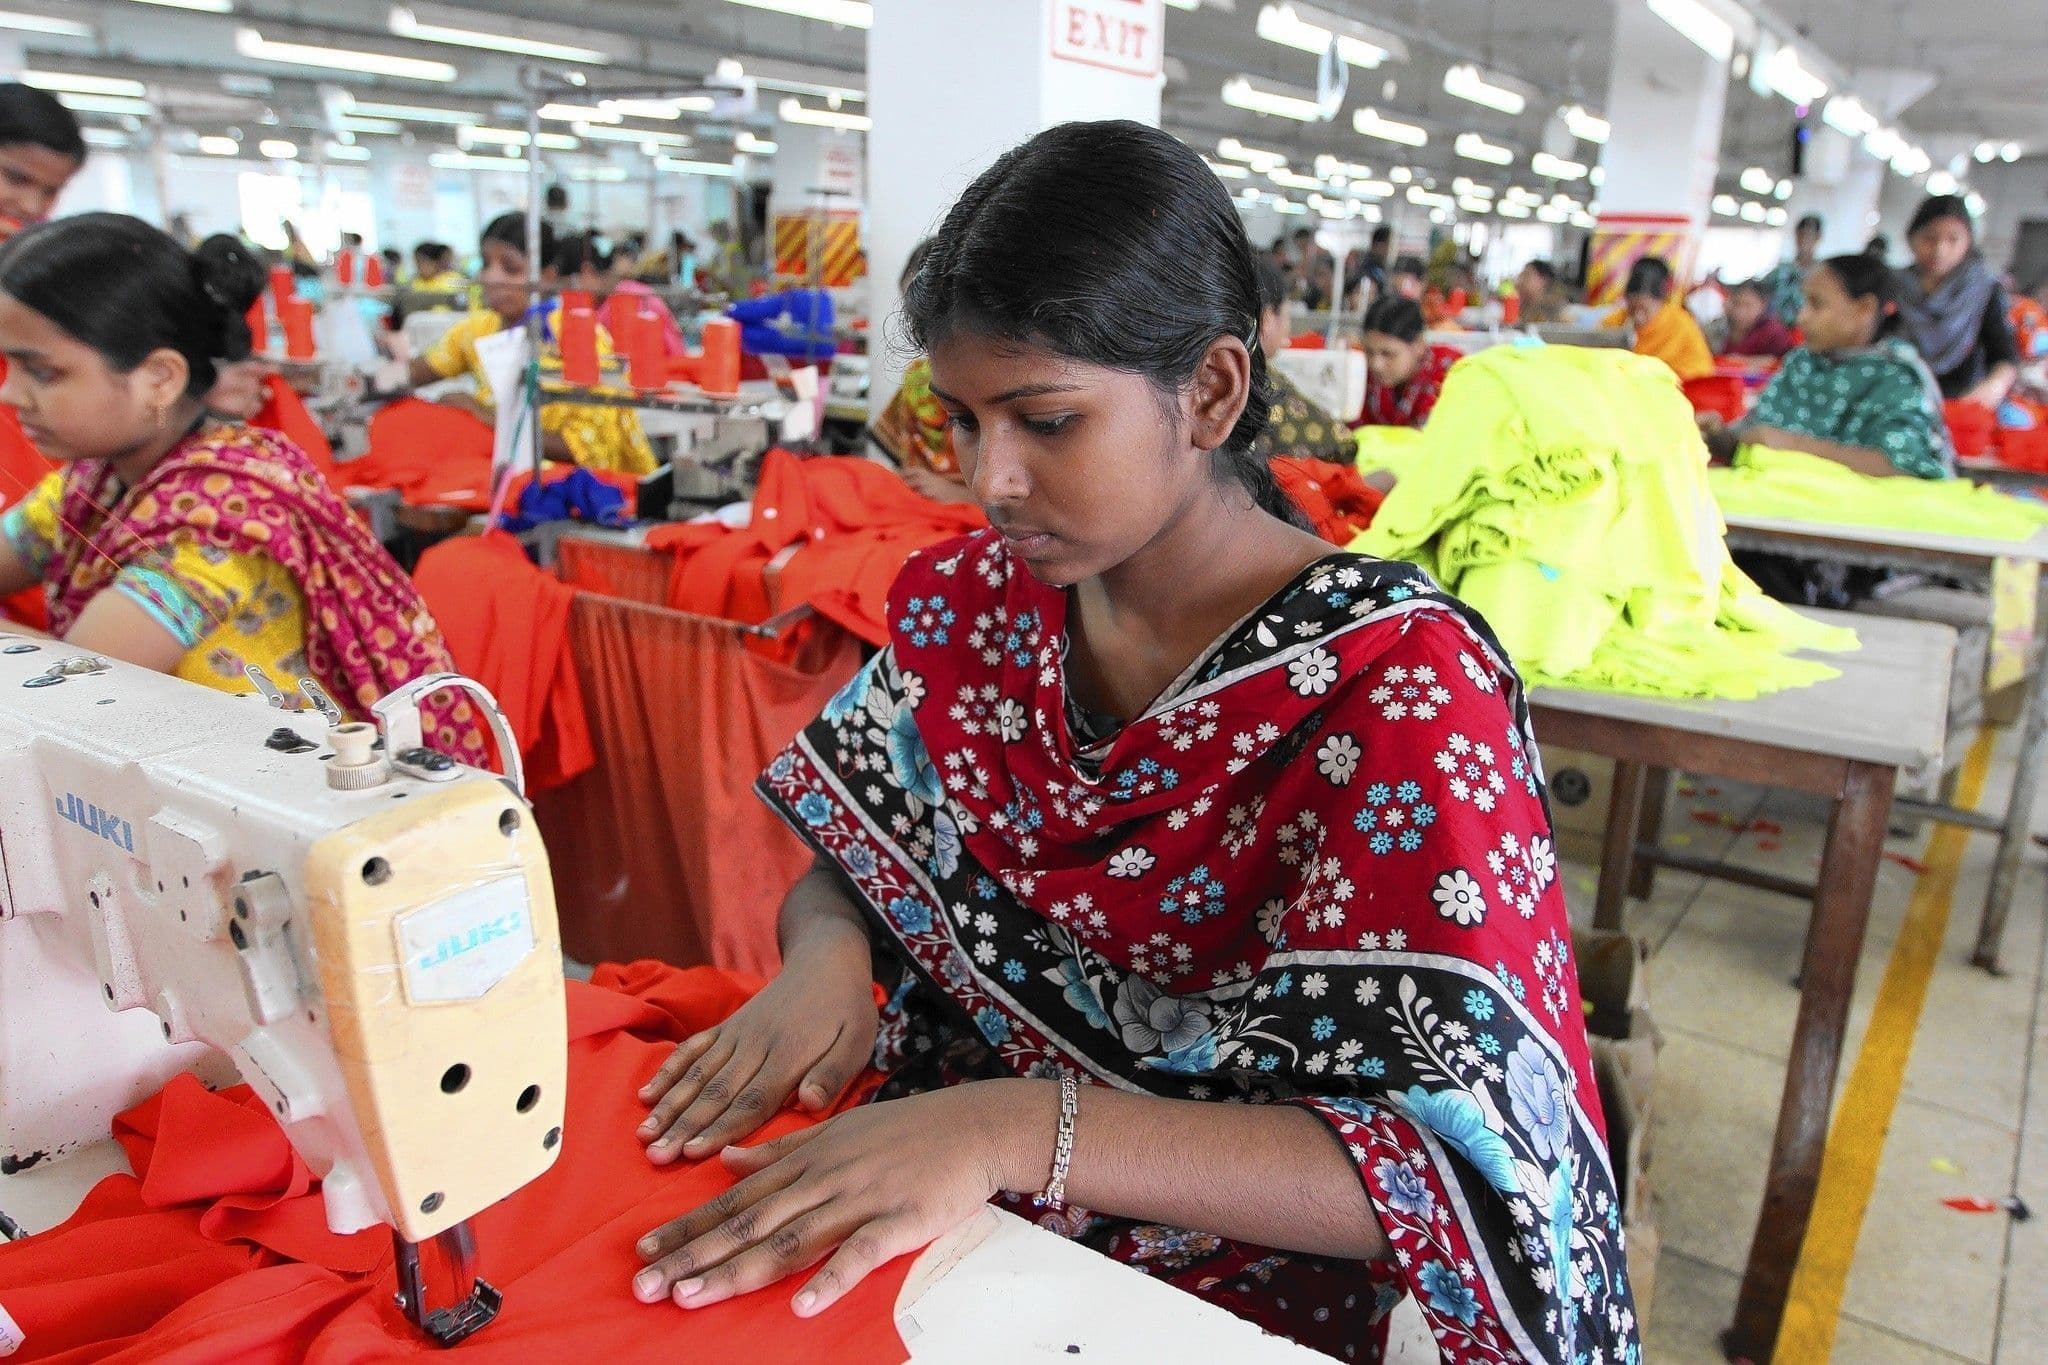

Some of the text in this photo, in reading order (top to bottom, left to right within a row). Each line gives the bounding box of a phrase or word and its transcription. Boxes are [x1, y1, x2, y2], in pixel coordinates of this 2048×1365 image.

[1067, 7, 1147, 59] EXIT
[56, 792, 134, 854] JUKI
[420, 911, 521, 969] JUKI
